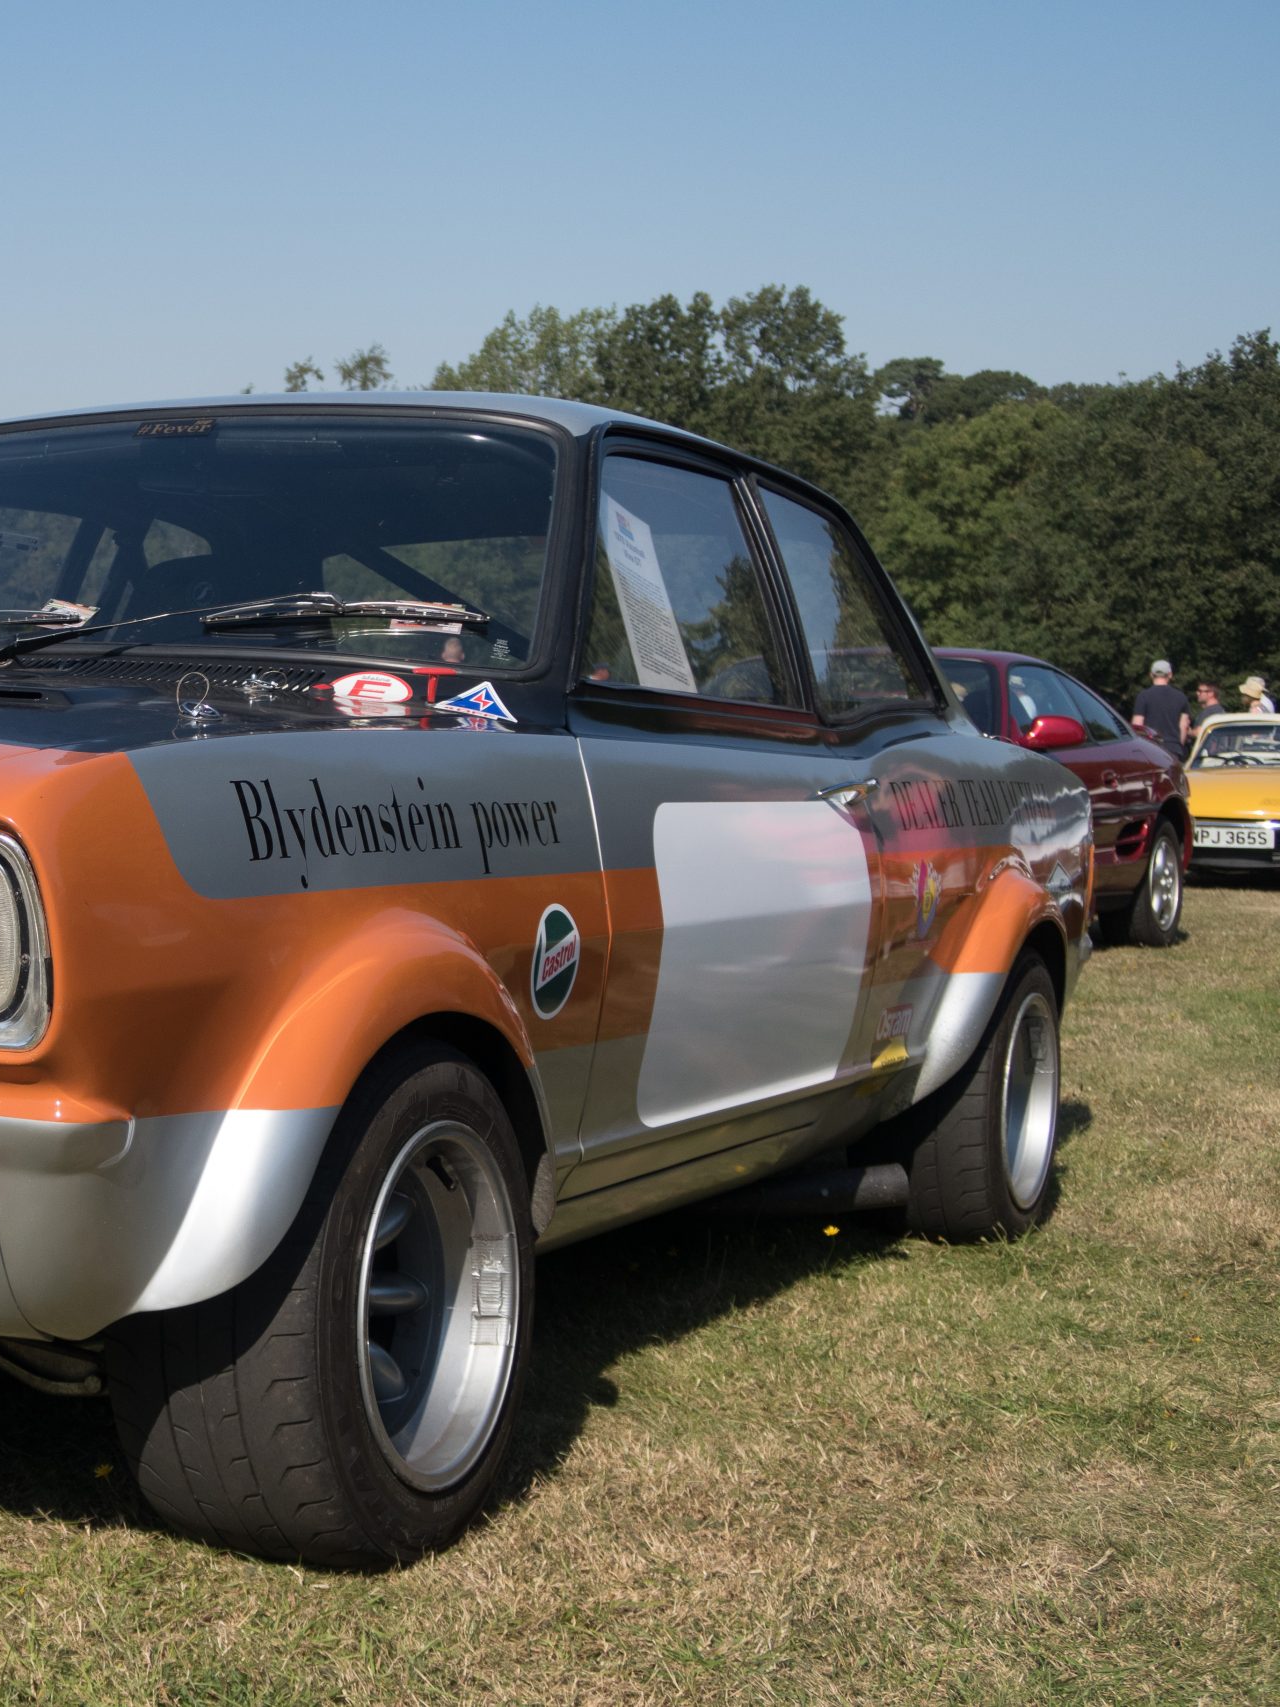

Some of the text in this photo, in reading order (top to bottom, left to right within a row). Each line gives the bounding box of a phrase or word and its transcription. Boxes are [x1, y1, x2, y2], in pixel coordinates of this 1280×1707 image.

[347, 679, 391, 699] E
[890, 780, 965, 831] DEALER
[958, 779, 1004, 826] TEAM
[230, 777, 560, 889] Blydenstein power
[1225, 831, 1268, 845] 365S
[542, 934, 577, 982] Castrol
[876, 1008, 913, 1041] Osram
